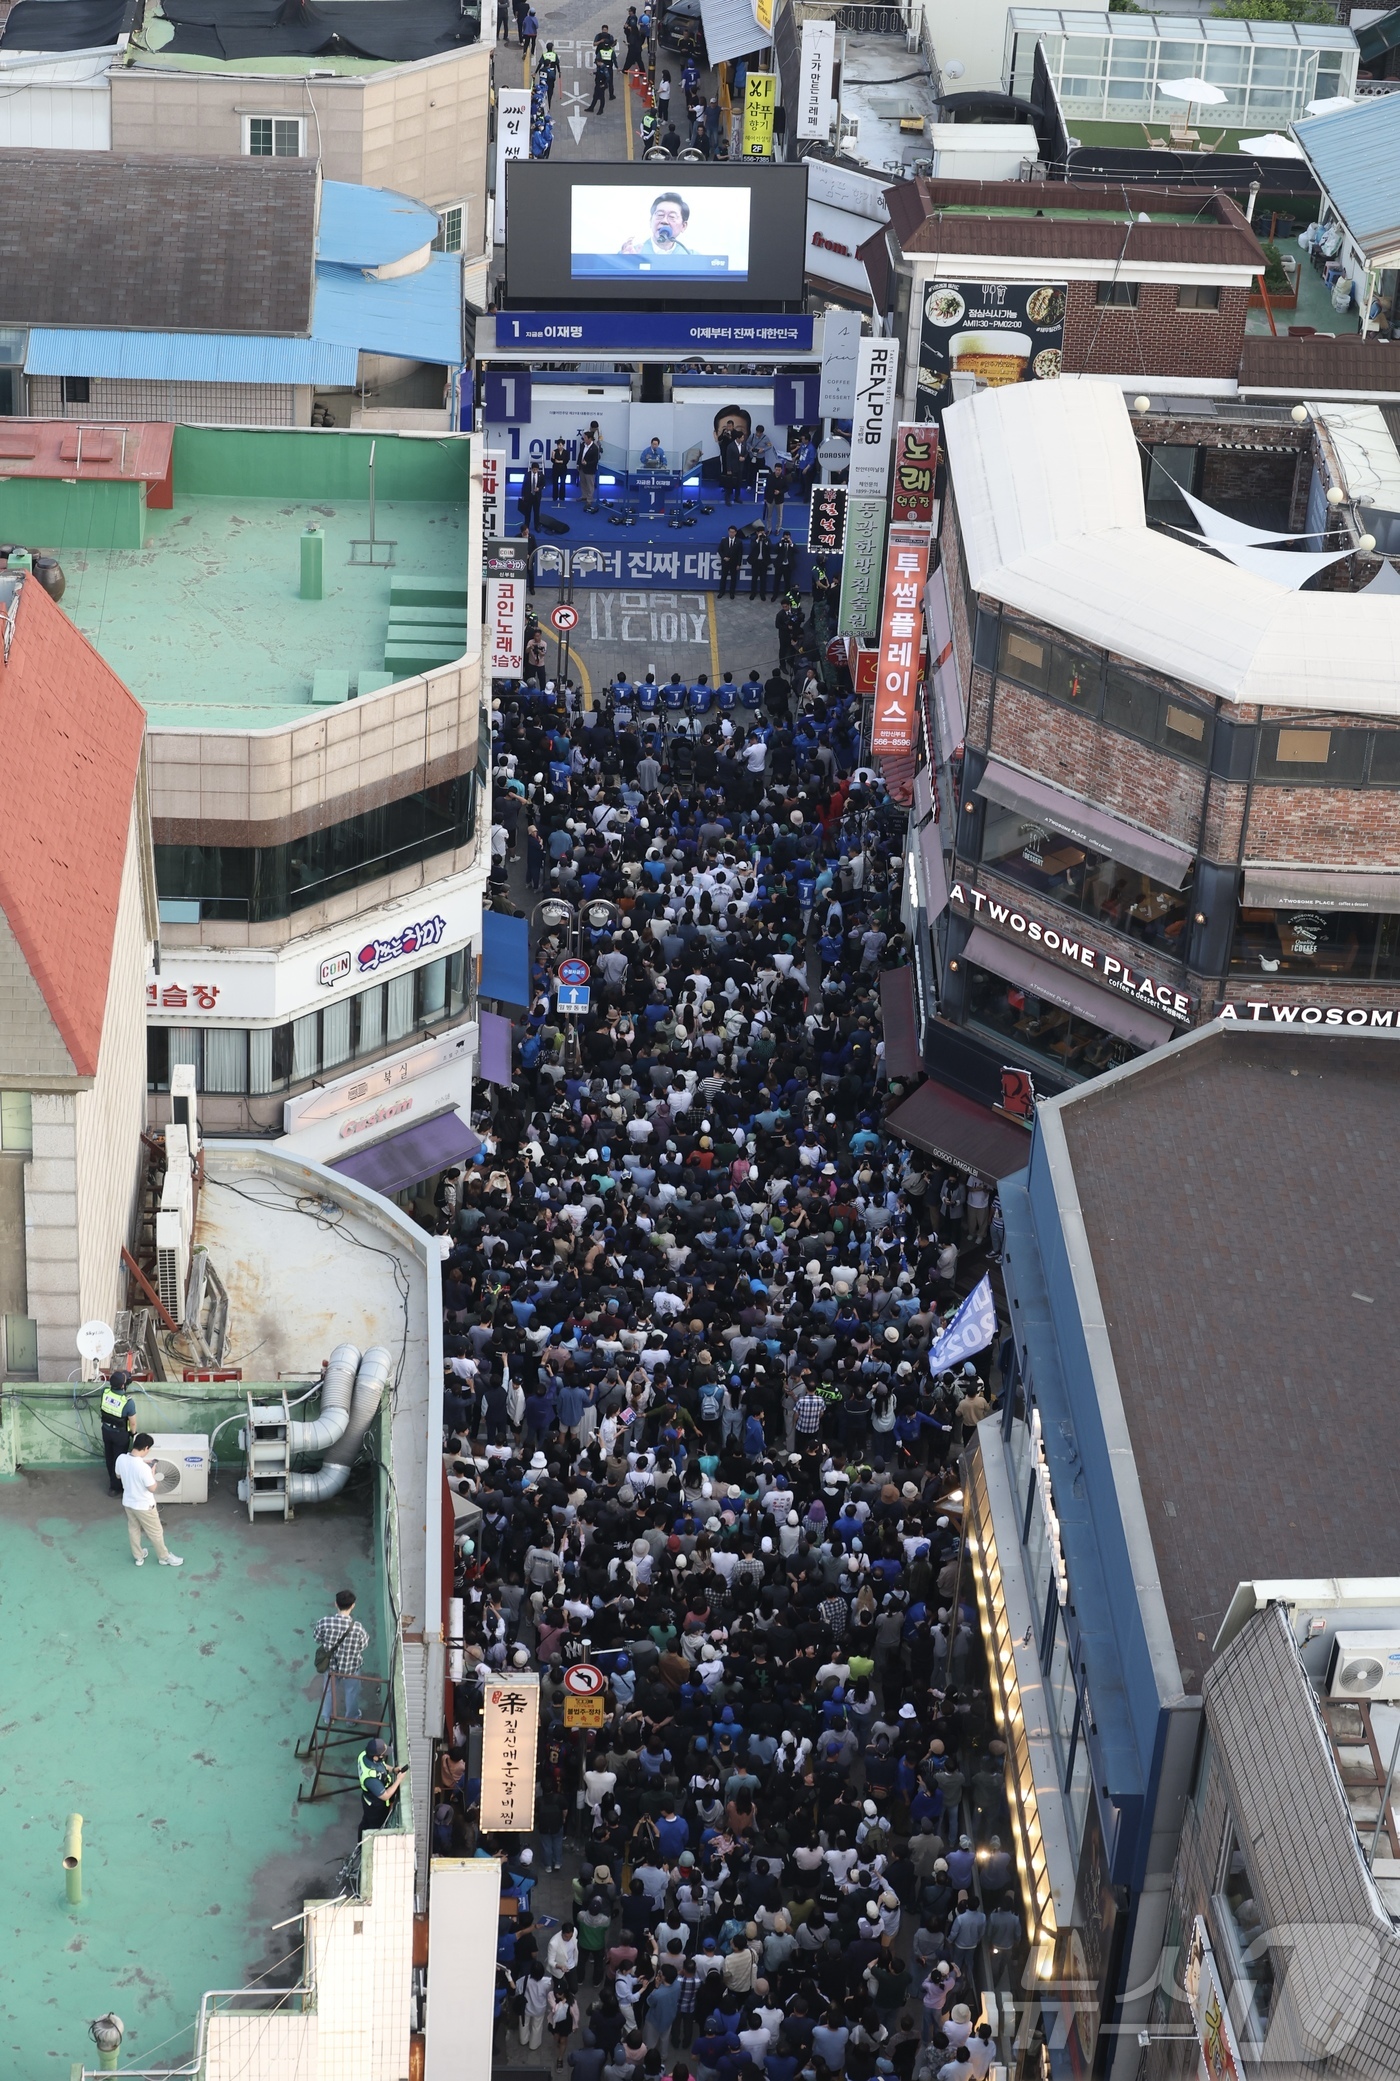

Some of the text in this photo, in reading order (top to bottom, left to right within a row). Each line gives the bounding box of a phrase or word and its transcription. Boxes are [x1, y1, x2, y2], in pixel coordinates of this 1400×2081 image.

[747, 102, 772, 119] 샴푸
[750, 121, 768, 131] 향기
[511, 321, 520, 337] 1
[544, 326, 583, 338] 이재명
[690, 328, 799, 339] 이제부터 진짜 대한민국
[501, 378, 516, 417] 1
[790, 381, 805, 419] 1
[857, 349, 888, 445] REALPUB
[507, 428, 521, 460] 1
[901, 434, 932, 492] 노래
[897, 495, 930, 508] 연습장
[628, 551, 681, 580] 진짜
[496, 584, 514, 652] 코인노래
[589, 592, 710, 644] 진입금지
[881, 553, 920, 723] 투썸플레이스
[950, 884, 1190, 1015] A TWOSOME PLACE
[322, 958, 348, 978] COIN
[1108, 978, 1130, 994] coffee
[1135, 990, 1160, 1009] dessert
[1218, 1002, 1400, 1027] A TWOSOM
[340, 1097, 413, 1139] Custom
[933, 1149, 978, 1177] GOSOO DAKGALBI
